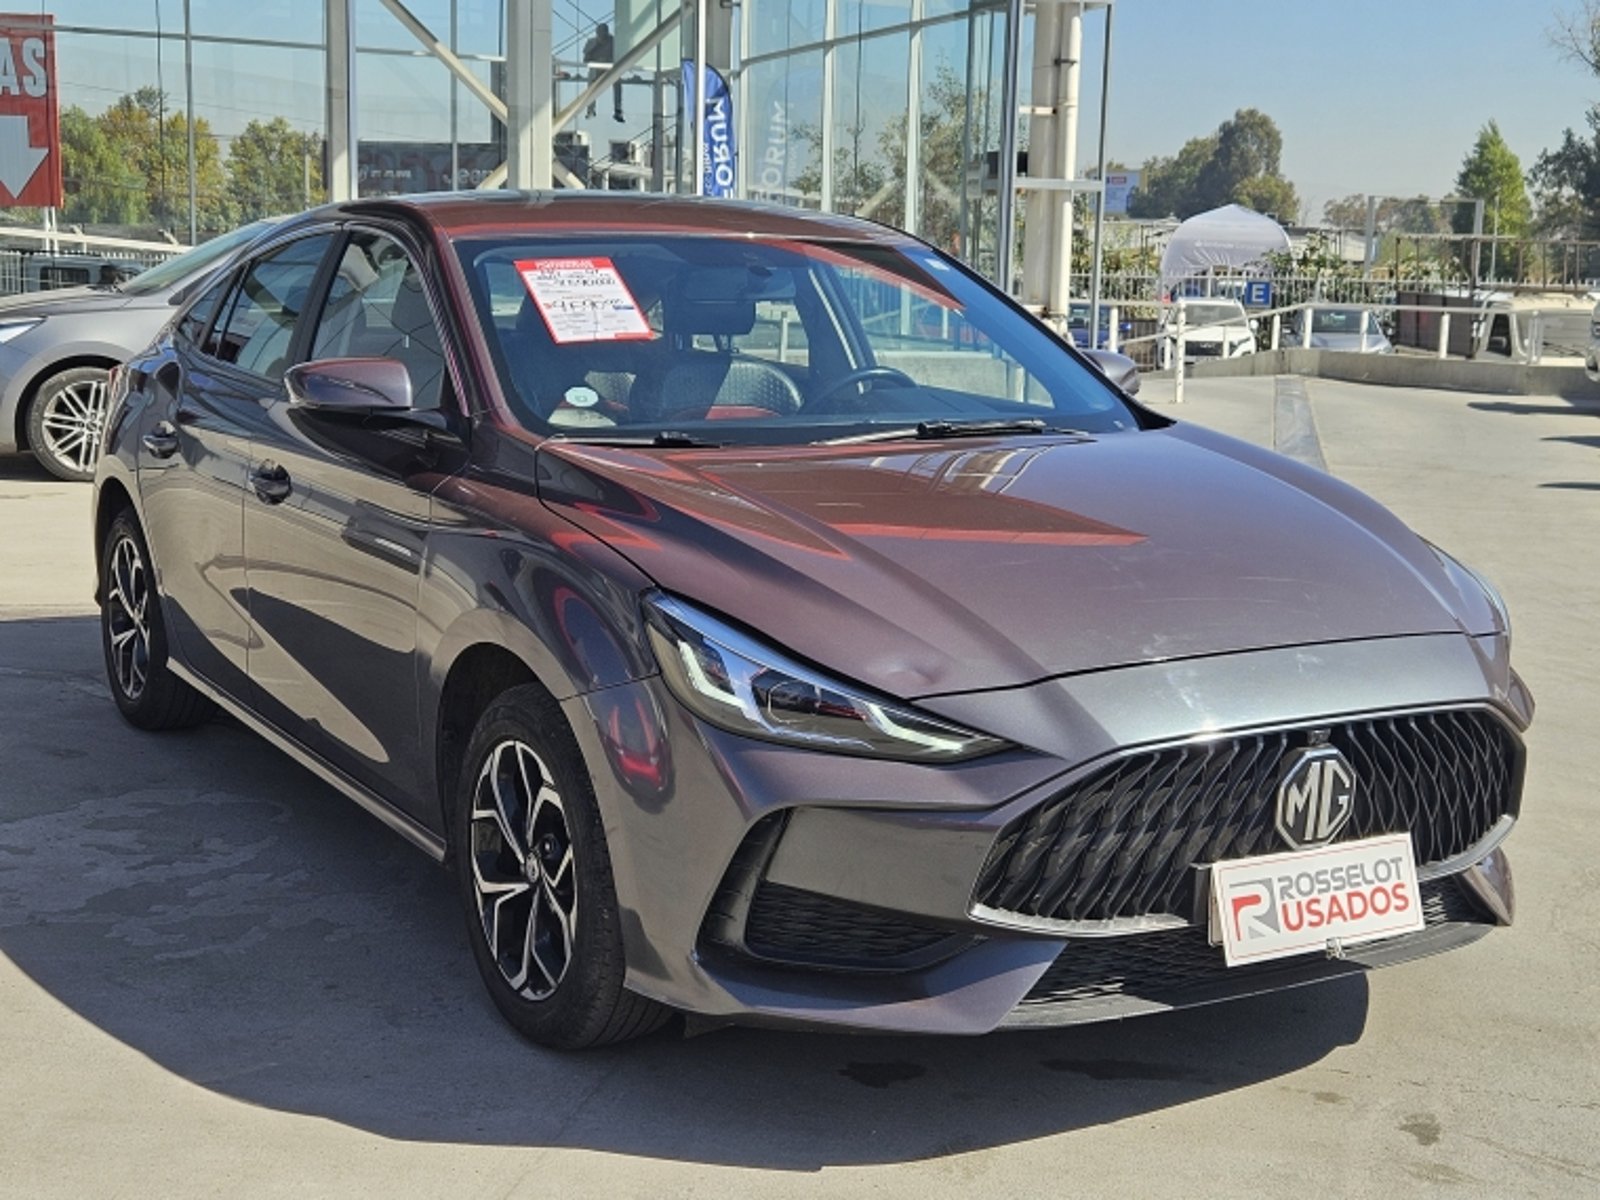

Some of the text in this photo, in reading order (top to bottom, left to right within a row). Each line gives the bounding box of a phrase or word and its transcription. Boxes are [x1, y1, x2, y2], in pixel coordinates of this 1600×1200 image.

[0, 37, 47, 98] AS
[1251, 283, 1265, 302] E
[1286, 759, 1350, 841] MG
[1278, 856, 1403, 900] ROSSELOT
[1281, 882, 1410, 932] USADOS
